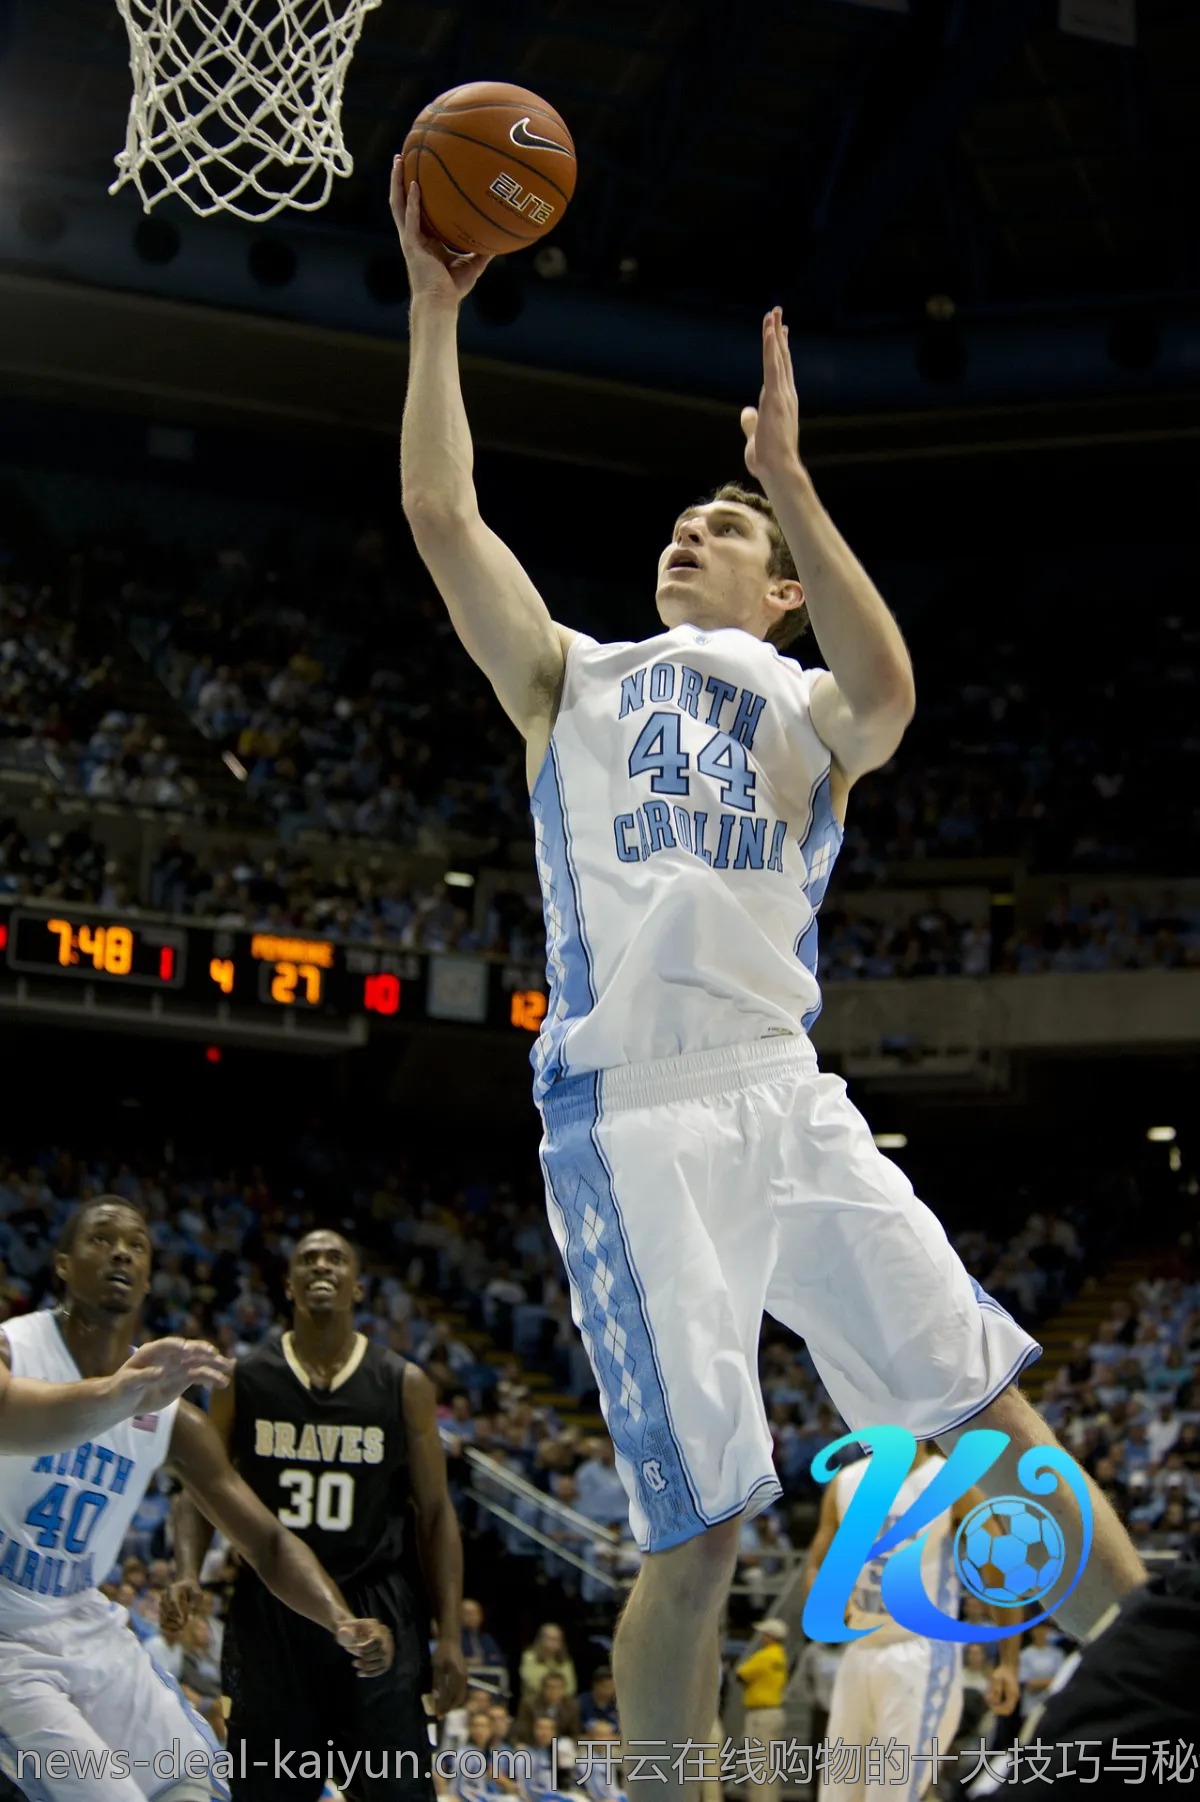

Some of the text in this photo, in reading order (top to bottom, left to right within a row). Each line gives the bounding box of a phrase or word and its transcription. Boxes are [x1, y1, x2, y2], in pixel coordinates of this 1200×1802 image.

[489, 172, 555, 224] ELITE
[618, 662, 767, 750] NORTH
[628, 711, 756, 812] 44
[613, 800, 787, 873] CAROLINA
[47, 918, 133, 975] 7:48
[210, 958, 234, 993] 4
[272, 961, 321, 1004] 27
[364, 972, 399, 1015] 10
[511, 991, 547, 1031] 12
[255, 1418, 385, 1464] BRAVES
[25, 1481, 109, 1554] 40
[278, 1468, 355, 1532] 30
